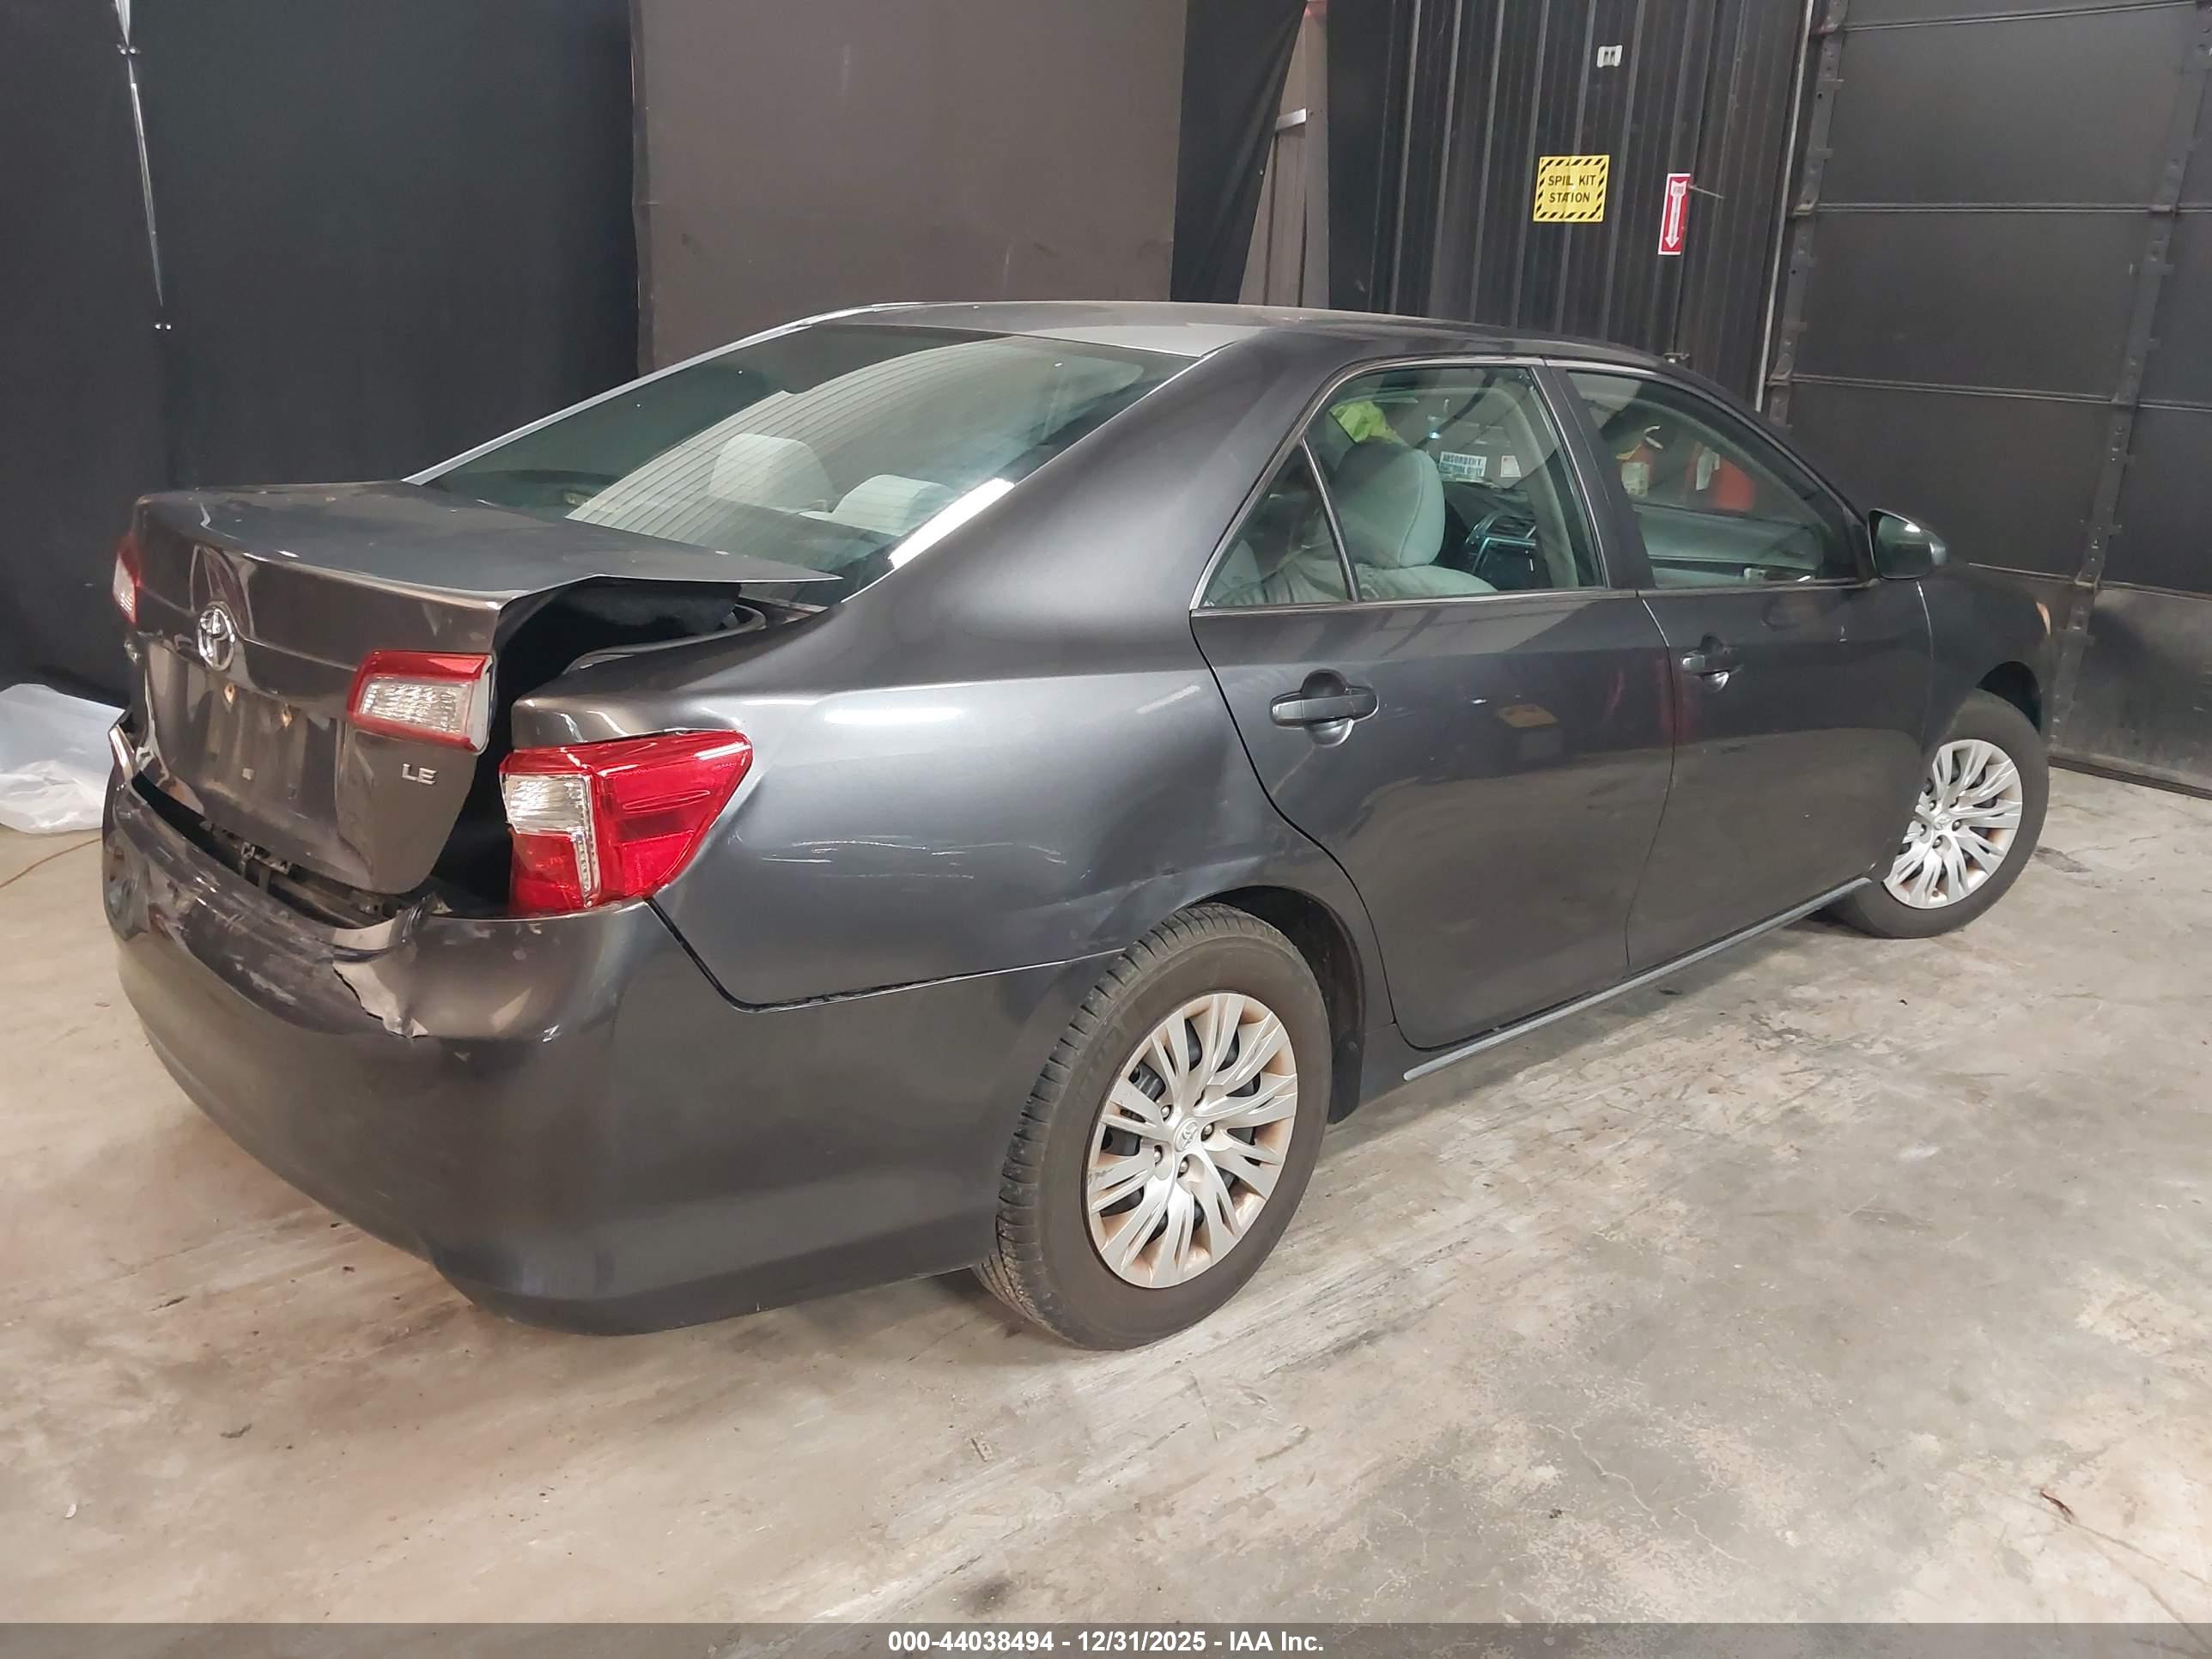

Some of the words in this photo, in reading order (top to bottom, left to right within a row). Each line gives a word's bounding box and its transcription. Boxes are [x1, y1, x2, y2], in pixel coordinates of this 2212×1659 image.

[1578, 174, 1596, 186] KIT
[1549, 191, 1590, 203] STATION
[402, 763, 437, 785] LE
